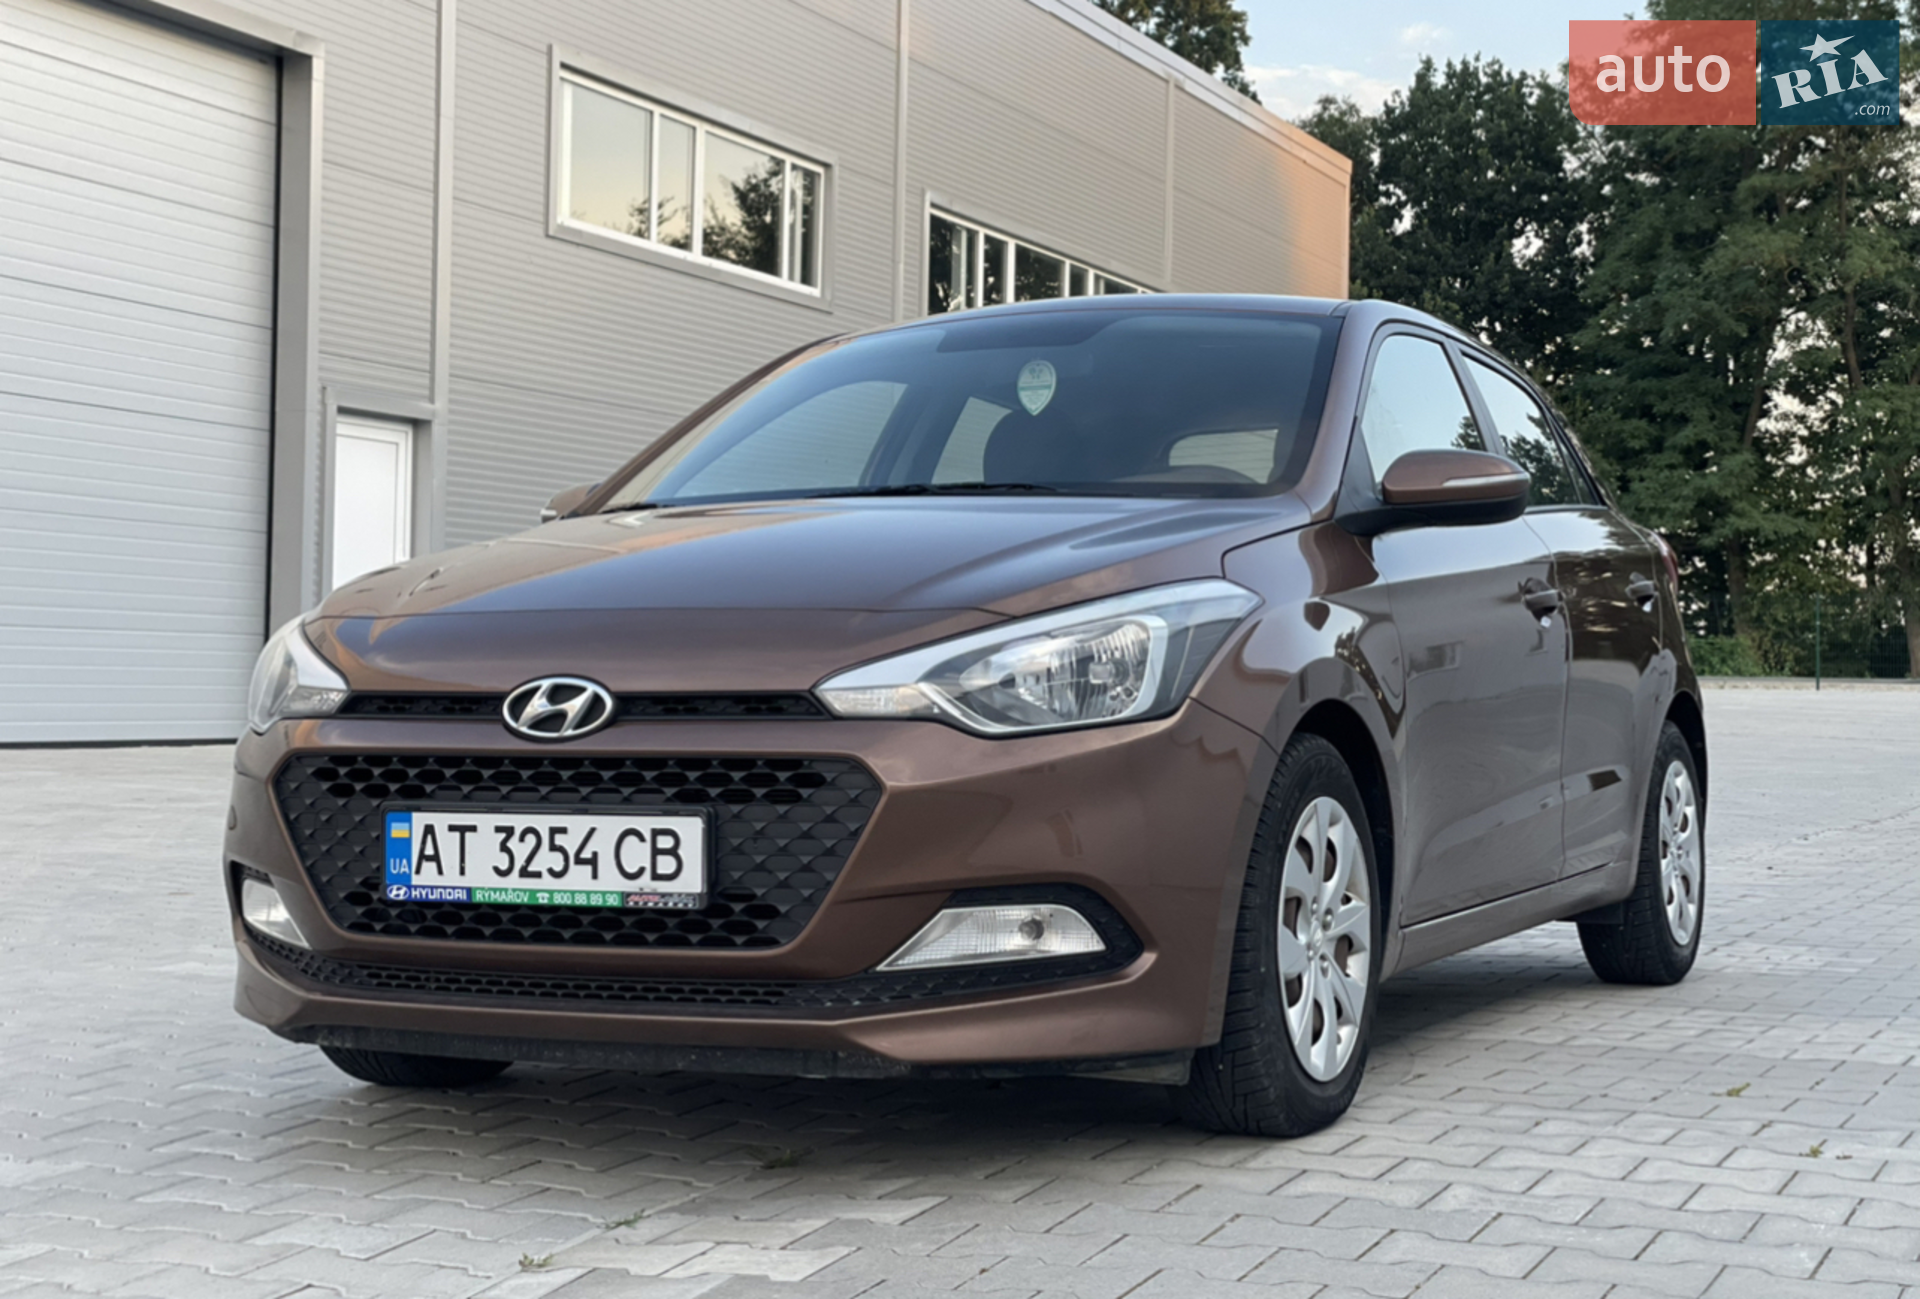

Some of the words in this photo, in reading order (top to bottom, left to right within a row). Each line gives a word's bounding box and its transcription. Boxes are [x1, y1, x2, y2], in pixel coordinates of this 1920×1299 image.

[414, 823, 478, 876] AT
[492, 825, 599, 880] 3254
[613, 827, 684, 882] CB
[390, 857, 410, 875] UA
[411, 887, 467, 900] HYUNDAI
[553, 892, 572, 904] 800
[574, 892, 587, 905] 88
[590, 893, 603, 905] 89
[605, 893, 618, 906] 90
